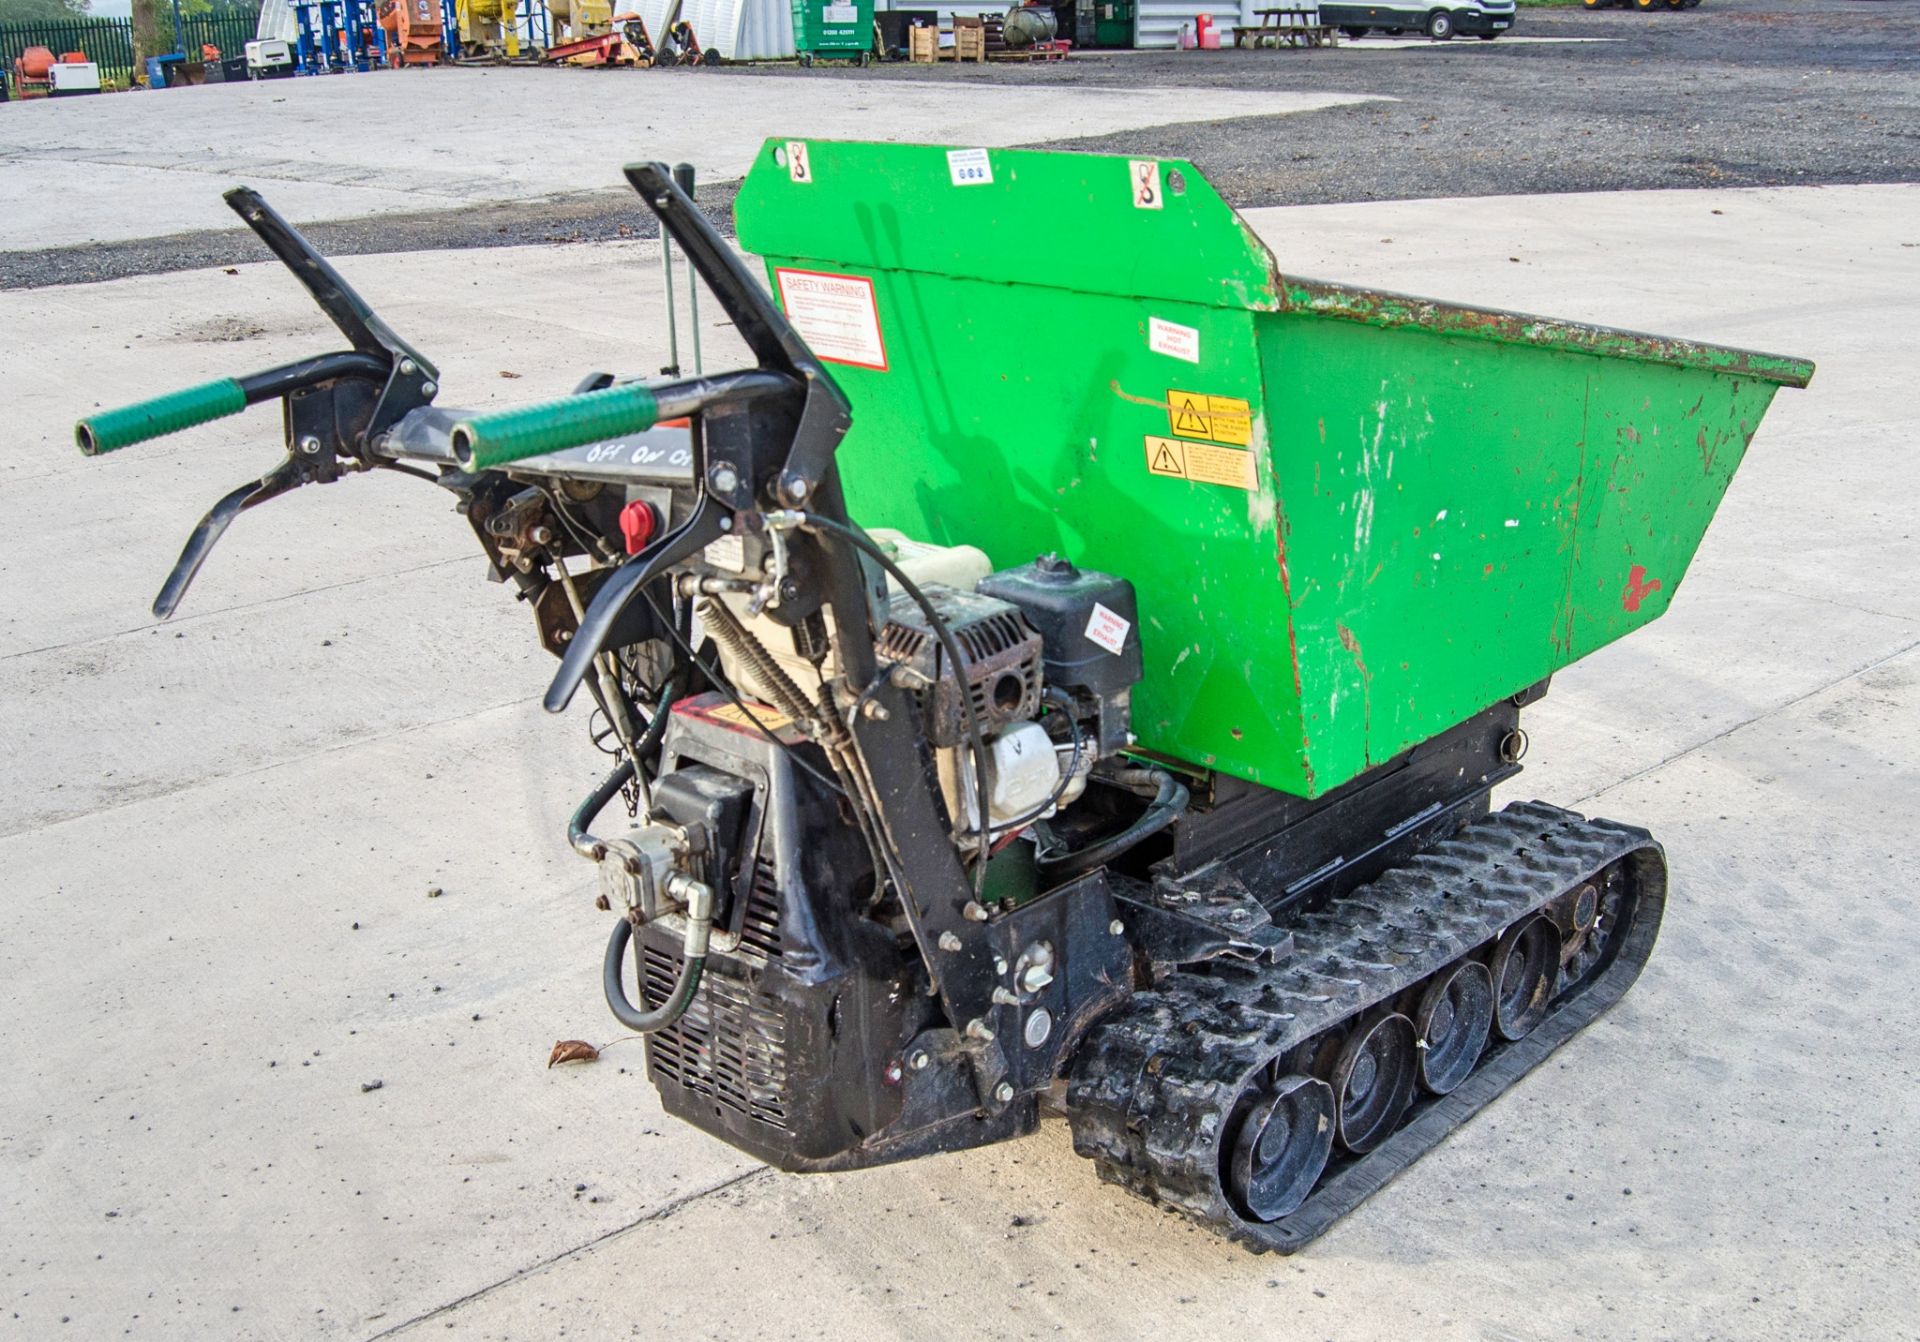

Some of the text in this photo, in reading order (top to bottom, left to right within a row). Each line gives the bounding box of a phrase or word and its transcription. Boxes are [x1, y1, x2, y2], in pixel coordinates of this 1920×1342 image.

[786, 277, 866, 297] SAFETY WARNING
[1157, 322, 1192, 339] WARNING
[1167, 335, 1182, 344] HOT
[1158, 341, 1191, 355] EXHAUST
[631, 445, 665, 465] ON
[1099, 611, 1125, 631] WARNING
[1092, 627, 1118, 647] EXHAUST
